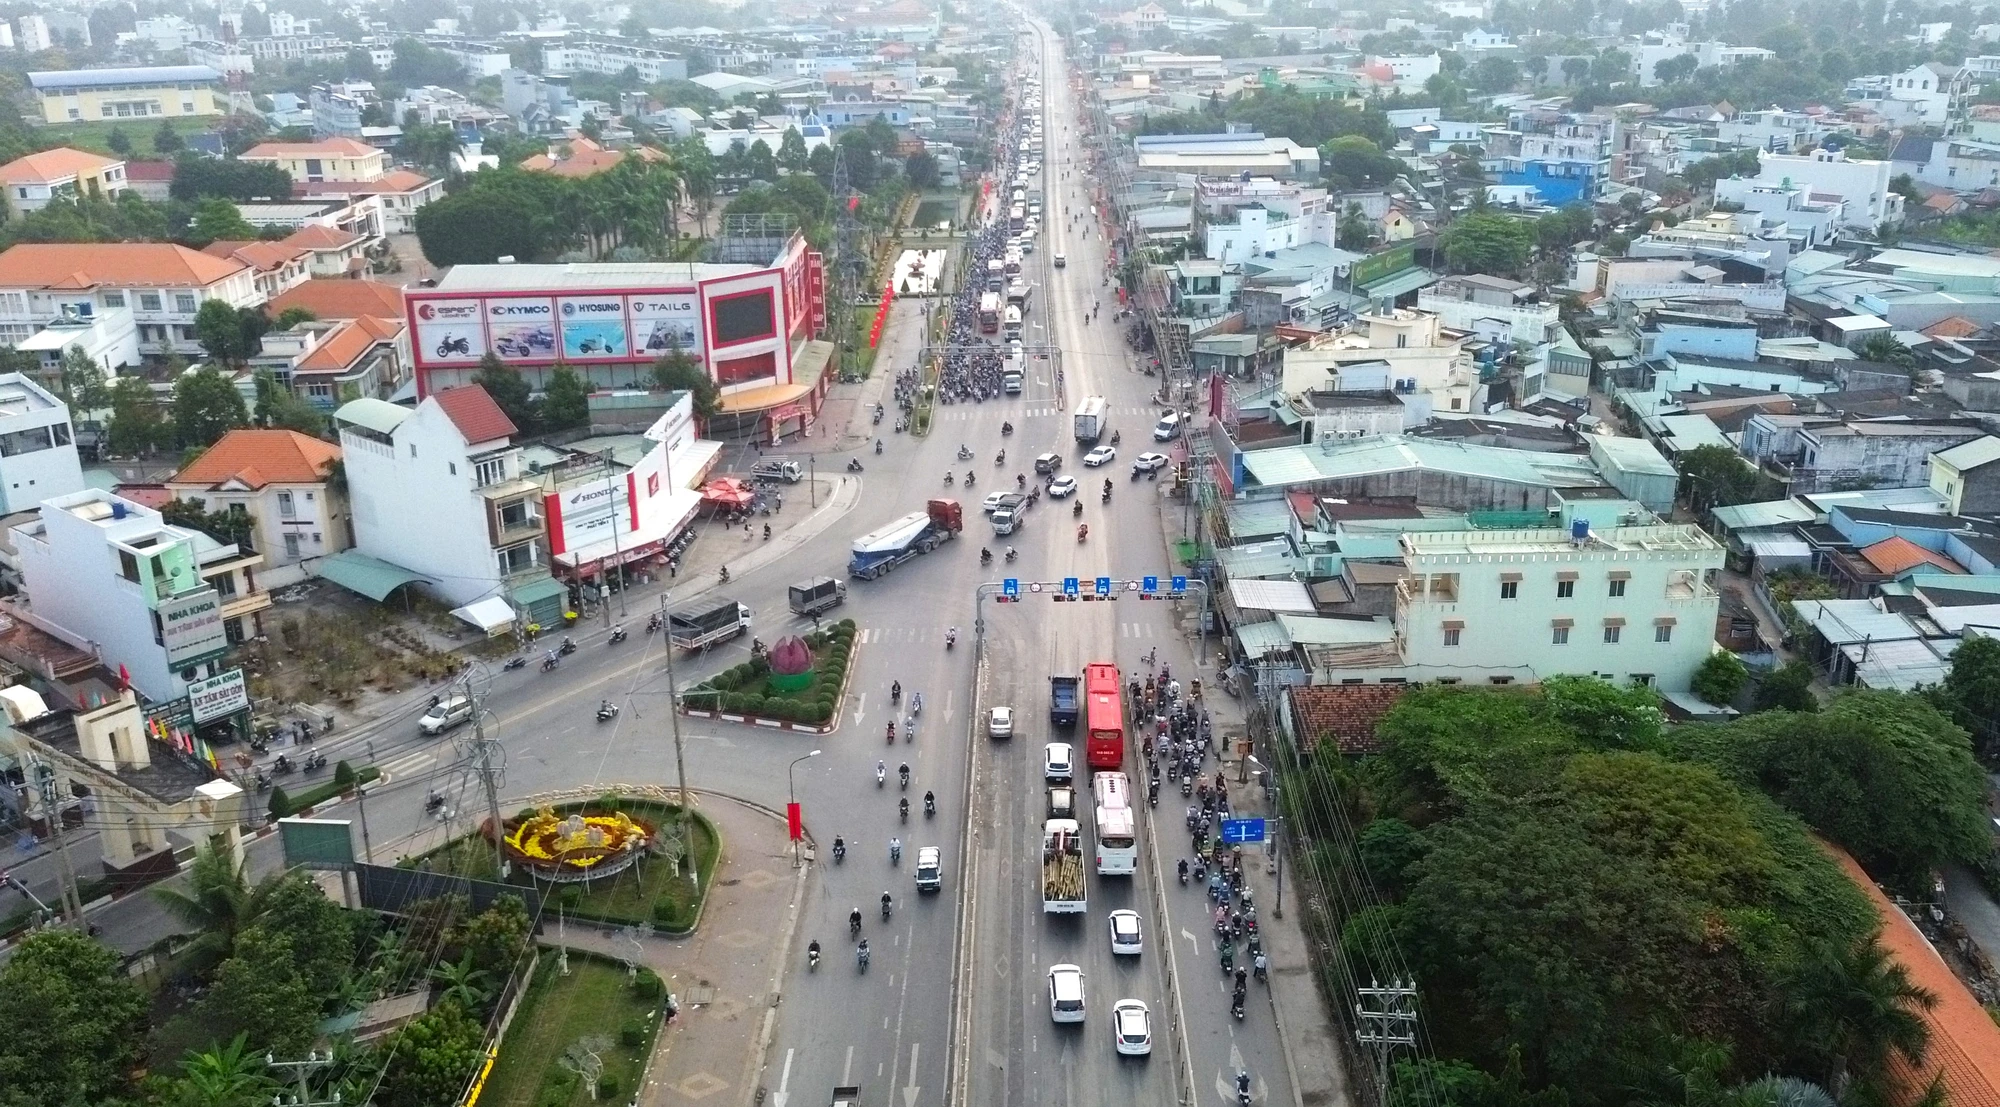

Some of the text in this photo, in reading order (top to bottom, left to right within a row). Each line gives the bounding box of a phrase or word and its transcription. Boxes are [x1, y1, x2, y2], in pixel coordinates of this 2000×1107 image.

[813, 276, 821, 285] XE
[508, 305, 550, 315] KYMCO
[579, 302, 620, 312] HYOSUNG
[648, 302, 691, 311] TAILG
[581, 484, 620, 502] HONDA
[168, 601, 216, 622] NHA KHOA
[206, 671, 242, 689] NHA KHOA
